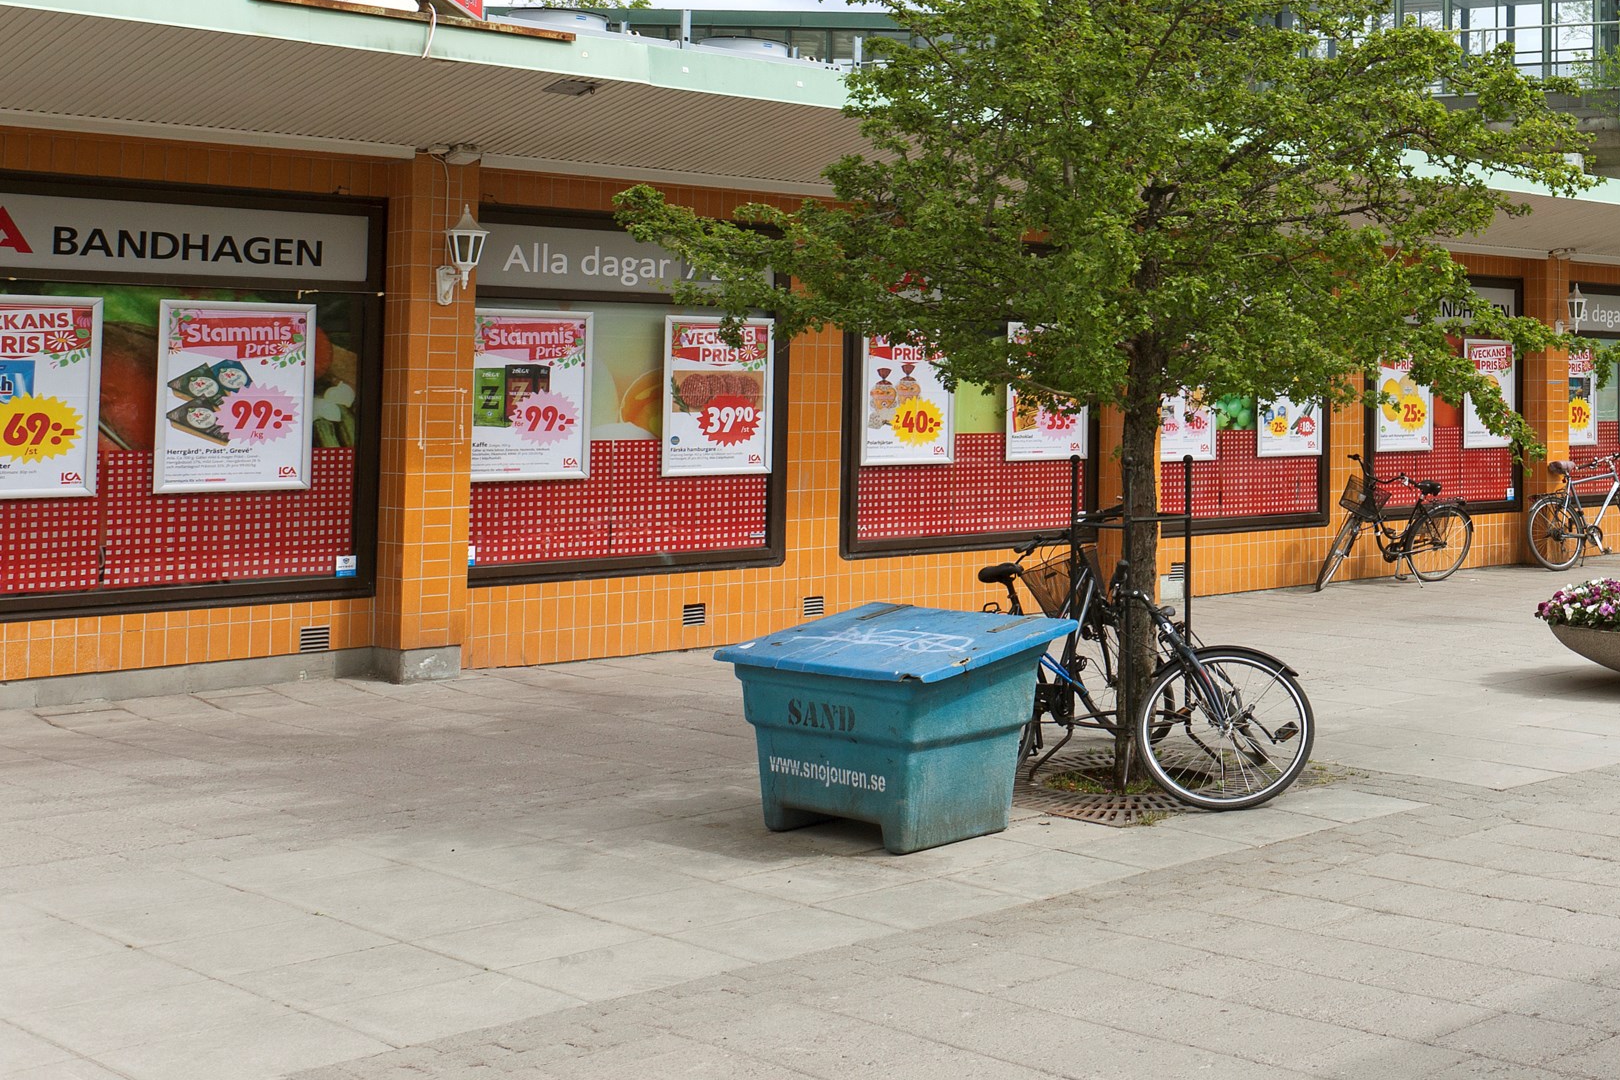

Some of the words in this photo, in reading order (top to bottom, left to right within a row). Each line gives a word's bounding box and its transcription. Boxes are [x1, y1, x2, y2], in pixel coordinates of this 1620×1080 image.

[52, 226, 324, 267] BANDHAGEN
[502, 243, 568, 275] Alla
[580, 246, 671, 286] dagar
[186, 321, 292, 343] Stammis
[488, 327, 574, 346] Stammis
[0, 335, 41, 354] RIS
[245, 341, 277, 358] Pris
[536, 346, 562, 360] Pris
[701, 348, 737, 362] PRIS
[894, 347, 923, 361] PRIS
[1471, 348, 1506, 359] VECKANS
[1481, 360, 1497, 370] PRIS
[231, 400, 293, 430] 99:-
[517, 410, 523, 419] 2
[526, 405, 574, 432] 99:-
[895, 414, 900, 424] 2
[1403, 404, 1425, 422] 25:-
[902, 410, 941, 433] 40:-
[3, 412, 75, 446] 69:-
[250, 430, 264, 439] /kg
[24, 447, 38, 455] /st
[934, 446, 944, 454] ICA
[563, 458, 578, 466] ICA
[748, 454, 761, 462] ICA
[61, 472, 81, 482] ICA
[279, 467, 297, 475] ICA
[787, 697, 856, 733] SAND
[769, 755, 887, 793] www.snojouren.se
